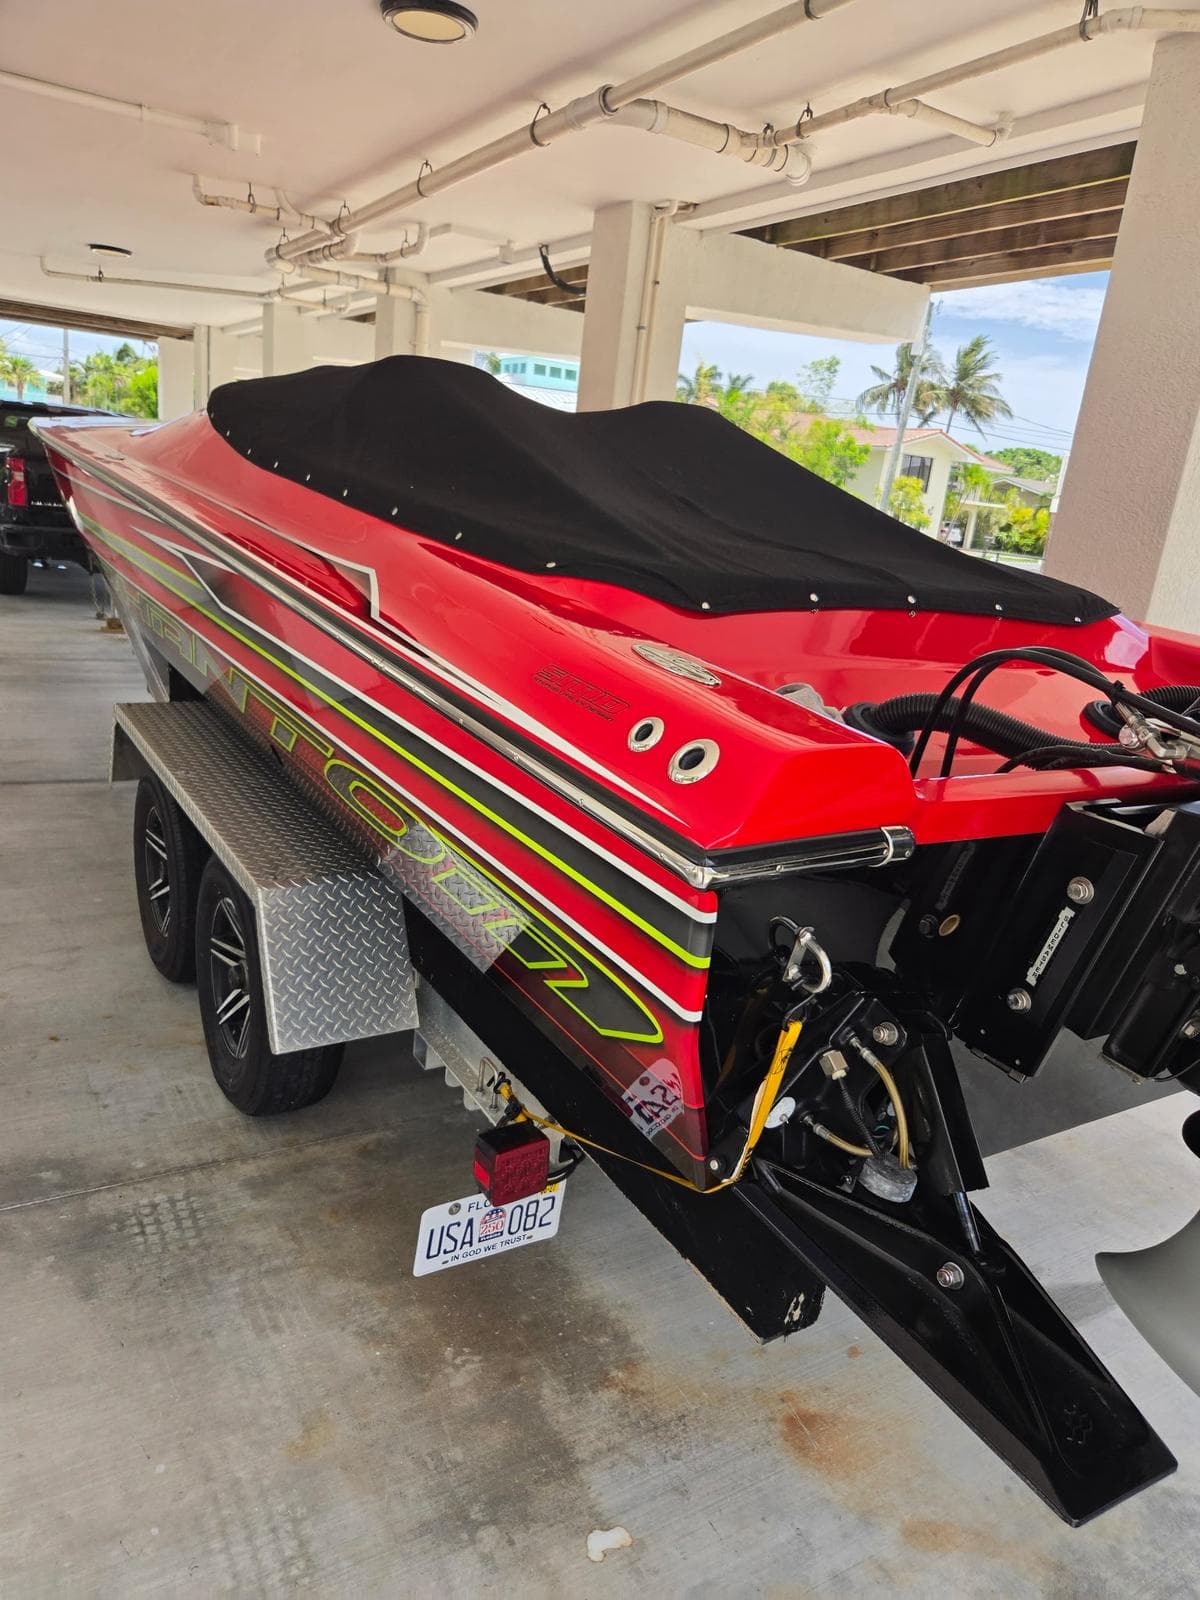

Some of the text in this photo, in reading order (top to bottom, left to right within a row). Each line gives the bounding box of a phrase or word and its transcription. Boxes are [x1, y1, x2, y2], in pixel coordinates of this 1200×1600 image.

[108, 565, 664, 1044] HANTOM
[426, 1217, 474, 1260] USA
[480, 1219, 504, 1236] 250
[450, 1234, 528, 1263] IN GOD WE TRUST
